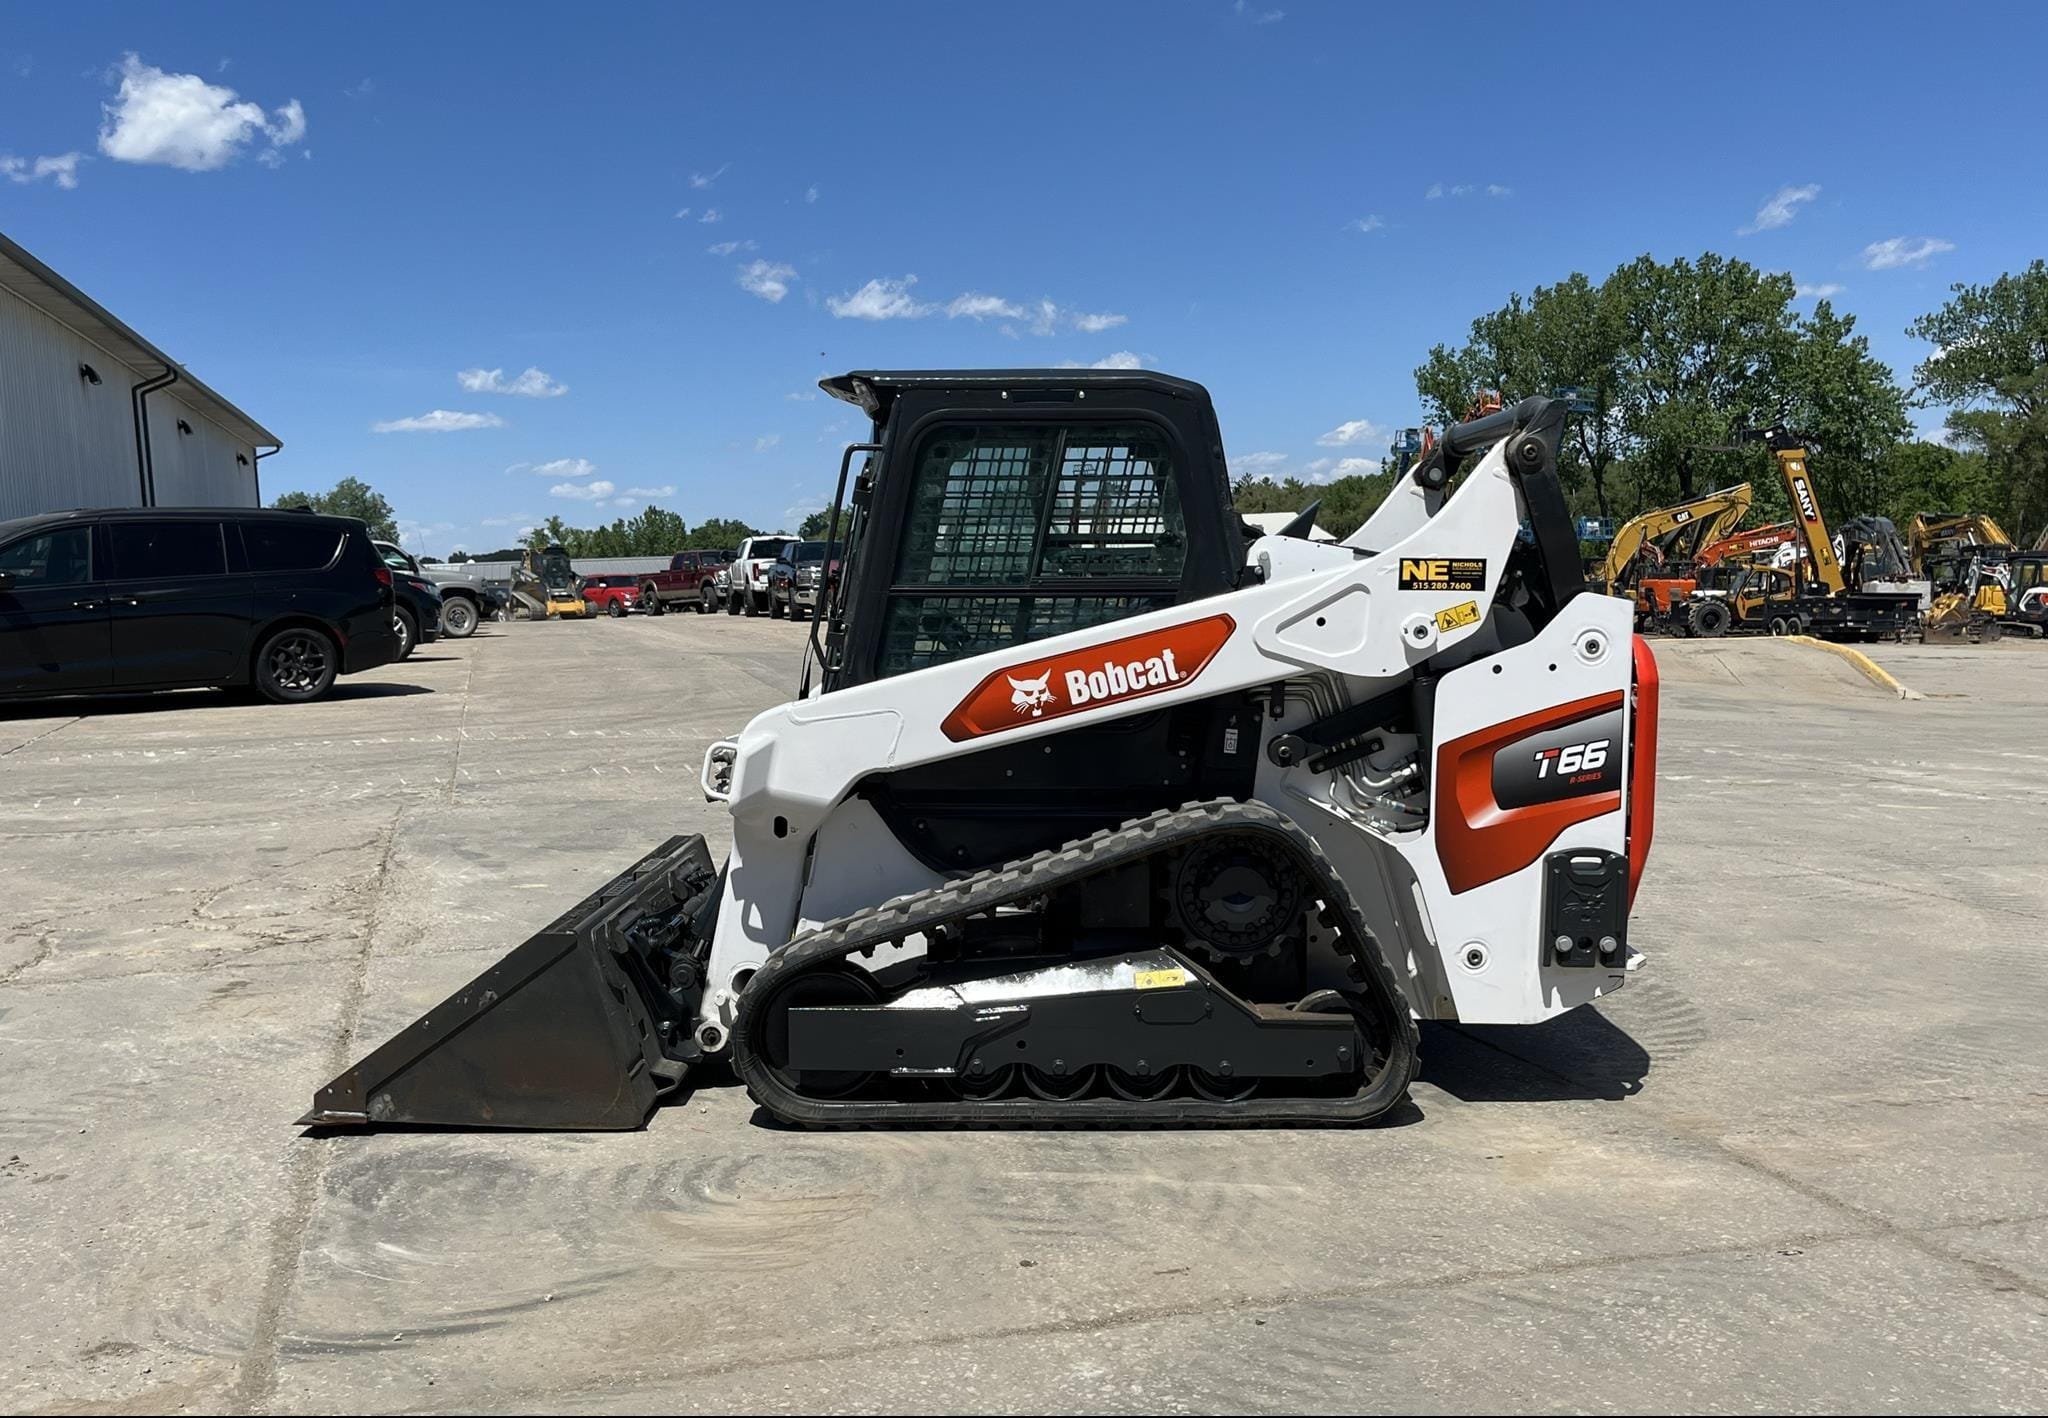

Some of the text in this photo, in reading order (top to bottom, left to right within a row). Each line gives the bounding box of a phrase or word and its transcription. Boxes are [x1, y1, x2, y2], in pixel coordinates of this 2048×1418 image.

[1794, 479, 1815, 518] SANY
[1676, 511, 1690, 522] CAT
[1749, 536, 1780, 548] HITACHI
[1402, 560, 1450, 581] NE
[1412, 582, 1472, 590] 515.280.7600
[1065, 648, 1179, 705] Bobcat
[1535, 740, 1610, 779] T66
[1569, 772, 1602, 784] R-SERIES
